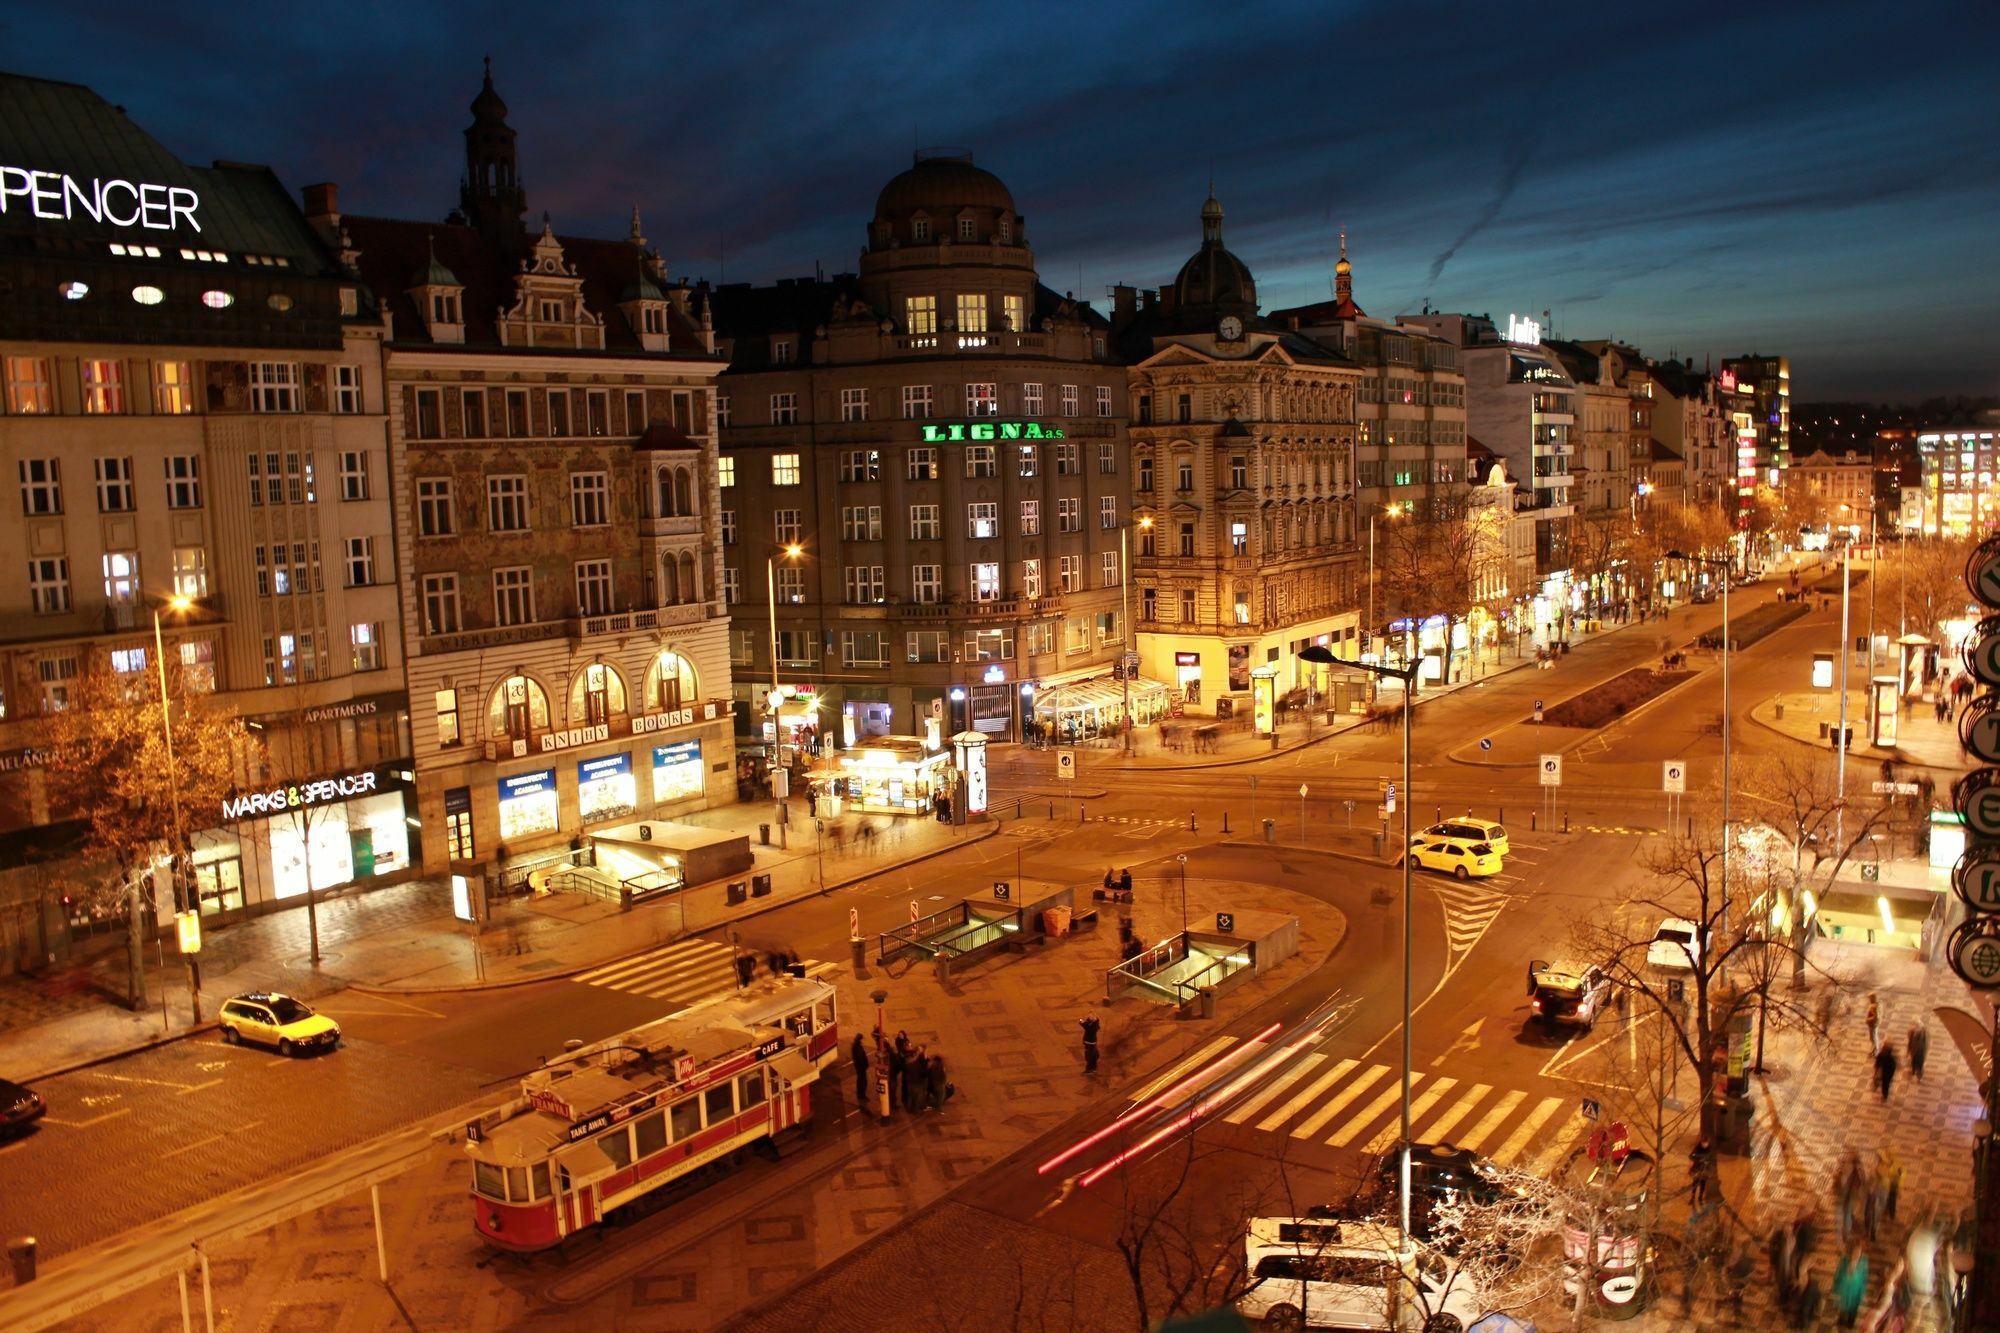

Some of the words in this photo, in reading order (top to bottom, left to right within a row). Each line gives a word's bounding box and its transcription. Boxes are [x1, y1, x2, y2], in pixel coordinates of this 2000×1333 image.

[922, 422, 1044, 442] LIGNA
[305, 701, 377, 723] APARTMENTS
[635, 711, 692, 731] BOOKS
[544, 728, 606, 748] KNIHY
[1670, 981, 1681, 996] P
[469, 1126, 477, 1139] 11
[570, 1125, 588, 1139] TAKE
